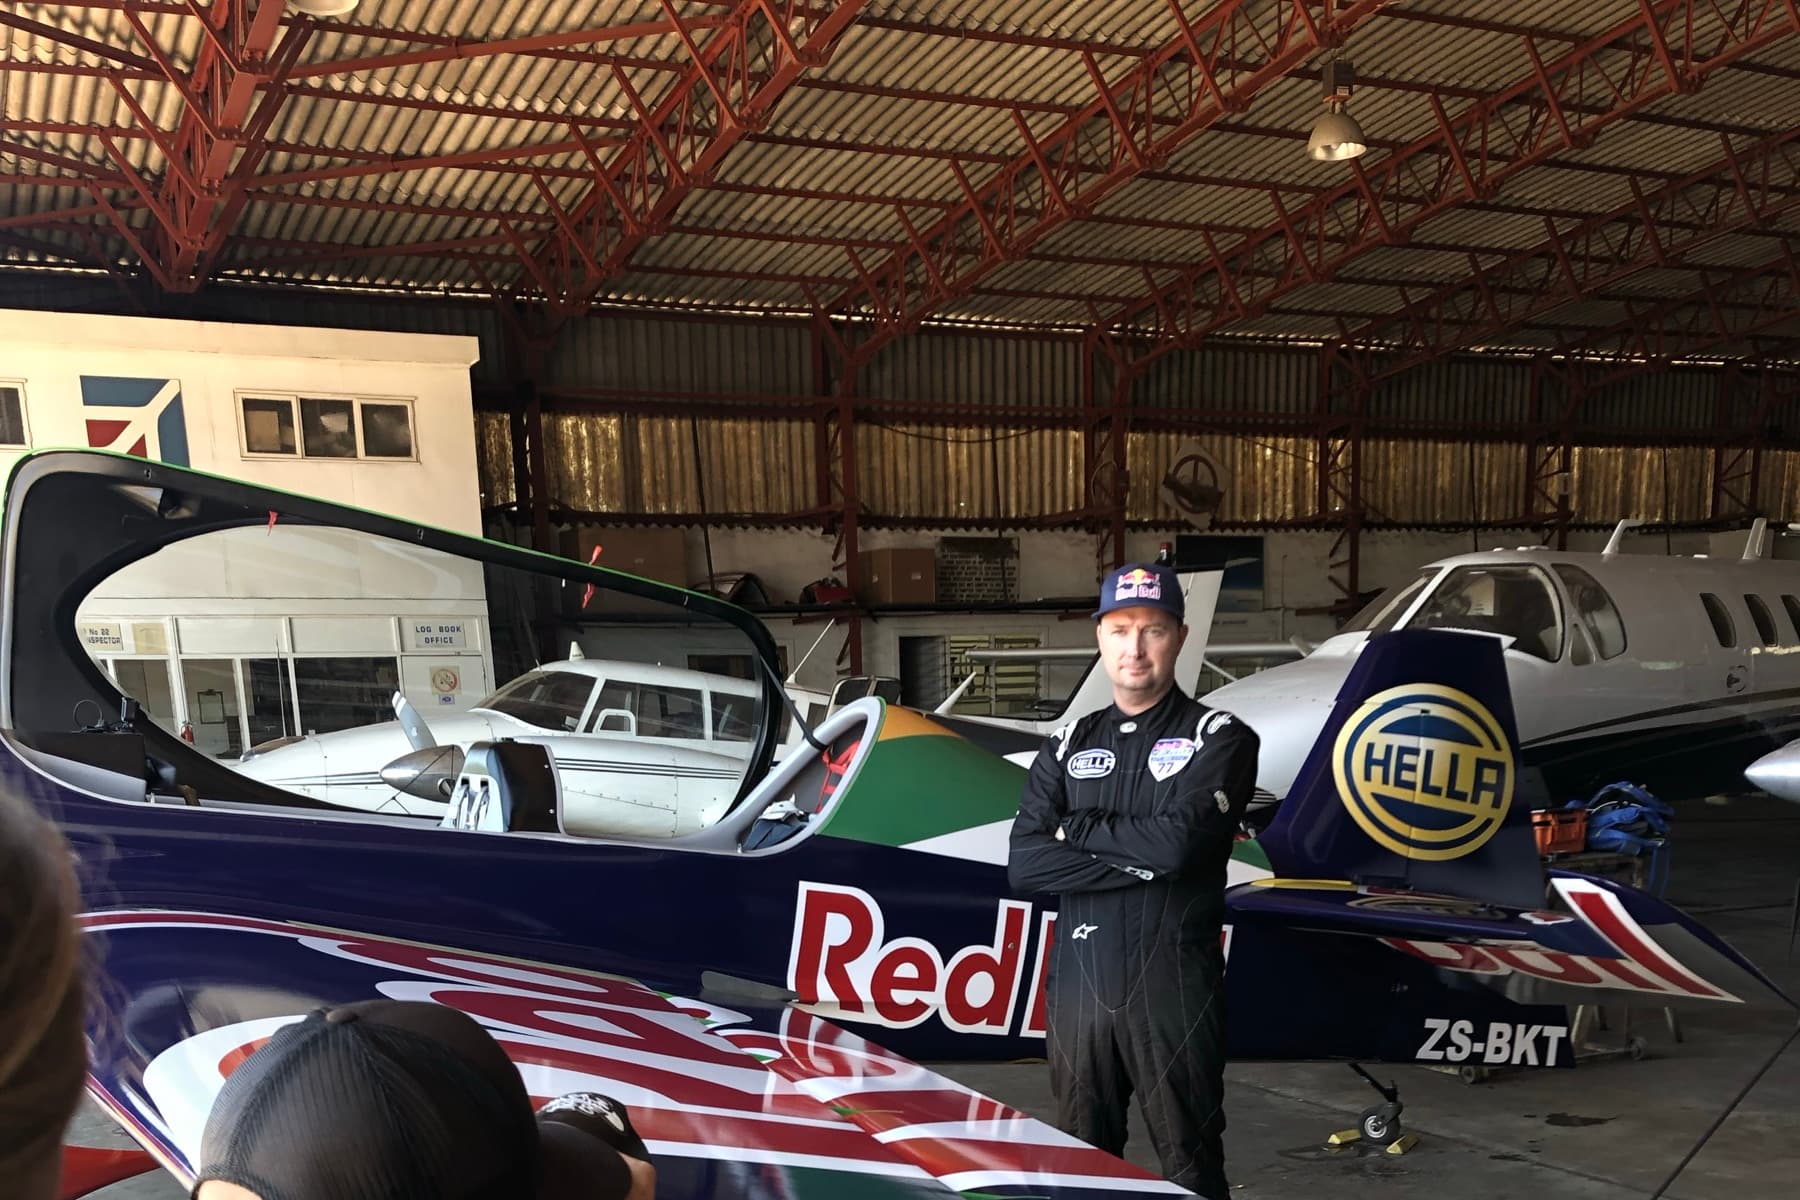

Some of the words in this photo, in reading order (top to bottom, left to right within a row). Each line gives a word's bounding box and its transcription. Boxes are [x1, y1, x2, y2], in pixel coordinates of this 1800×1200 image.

[415, 625, 432, 633] LOG
[438, 625, 462, 633] BOOK
[424, 636, 453, 644] OFFICE
[1072, 757, 1116, 769] HELLA
[1158, 762, 1175, 773] 77
[1363, 741, 1507, 810] HELLA
[787, 880, 1033, 1037] Red
[1415, 1017, 1569, 1067] ZS-BKT
